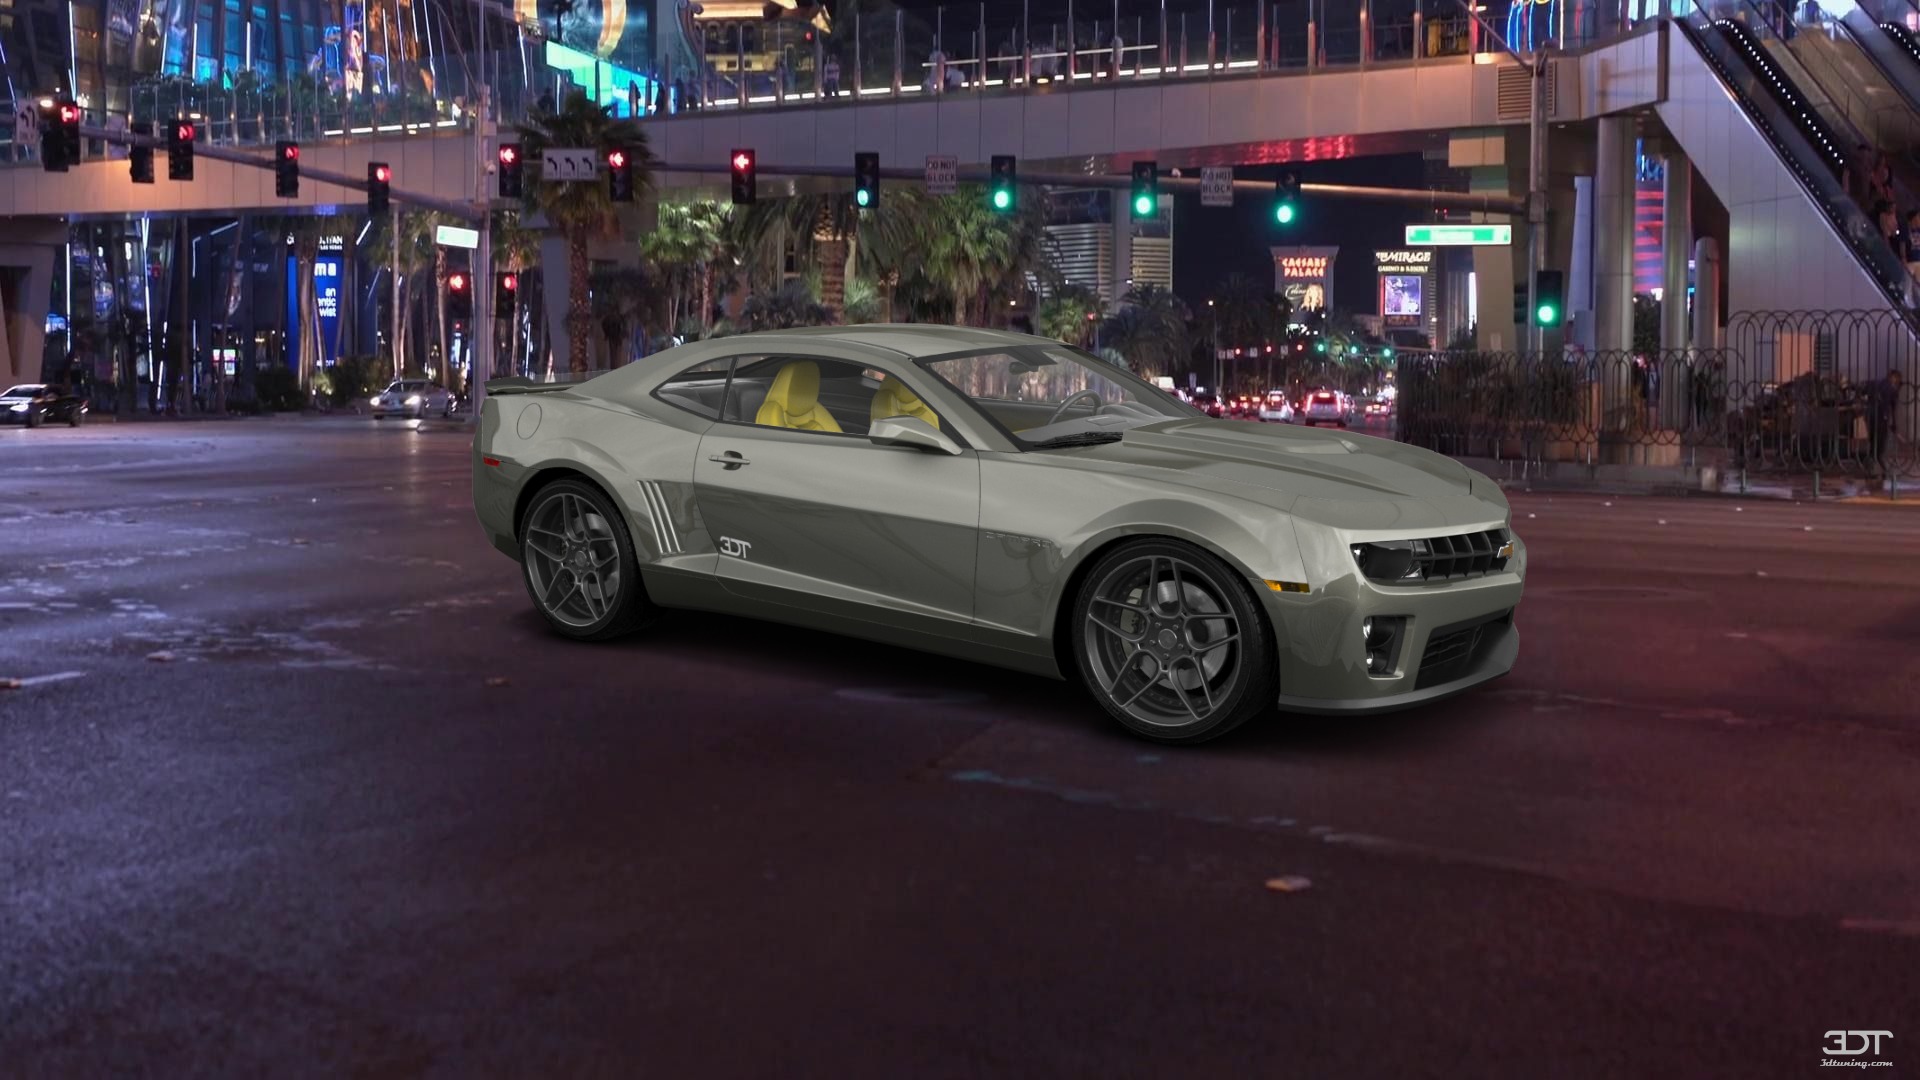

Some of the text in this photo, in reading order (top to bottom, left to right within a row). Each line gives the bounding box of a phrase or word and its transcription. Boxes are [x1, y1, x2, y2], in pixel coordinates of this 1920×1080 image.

[1282, 257, 1326, 267] CAESARS
[1388, 252, 1431, 263] MIRAGE
[1284, 267, 1324, 277] PALACE
[720, 536, 752, 559] 3DT
